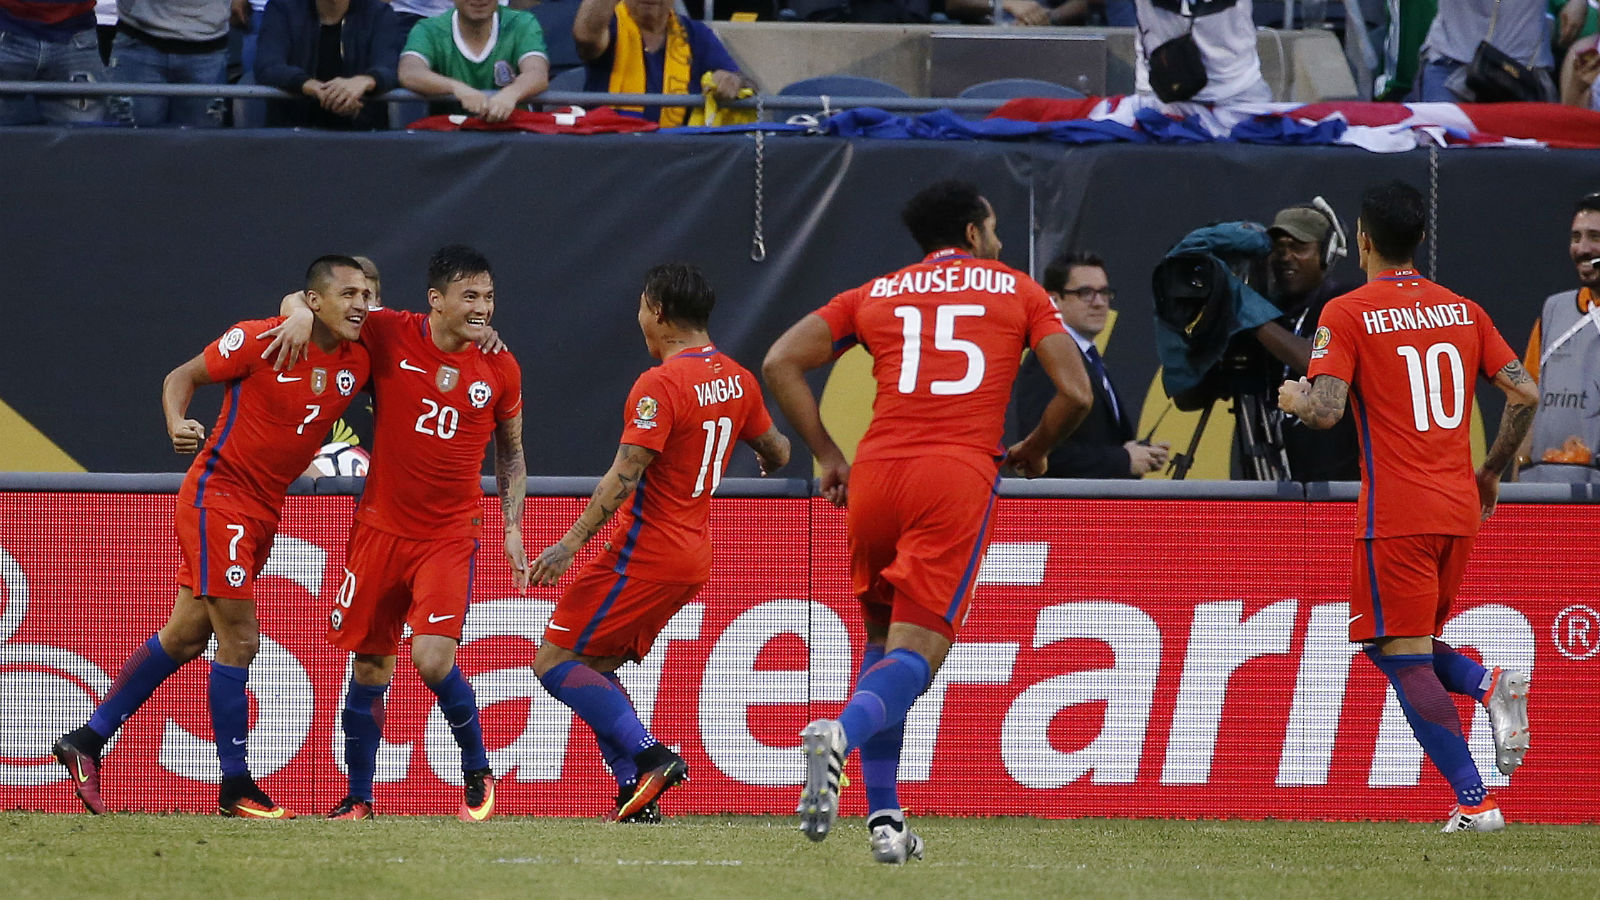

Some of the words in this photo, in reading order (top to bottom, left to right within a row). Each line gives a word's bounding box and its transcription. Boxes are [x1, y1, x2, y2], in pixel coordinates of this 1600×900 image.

[1362, 301, 1474, 335] HERNÁNDEZ
[894, 304, 986, 396] 15
[693, 374, 744, 408] VARGAS
[1396, 342, 1465, 432] 10
[1543, 388, 1588, 412] print
[296, 404, 321, 435] 7
[414, 398, 459, 440] 20
[691, 416, 733, 498] 11
[226, 524, 245, 562] 7
